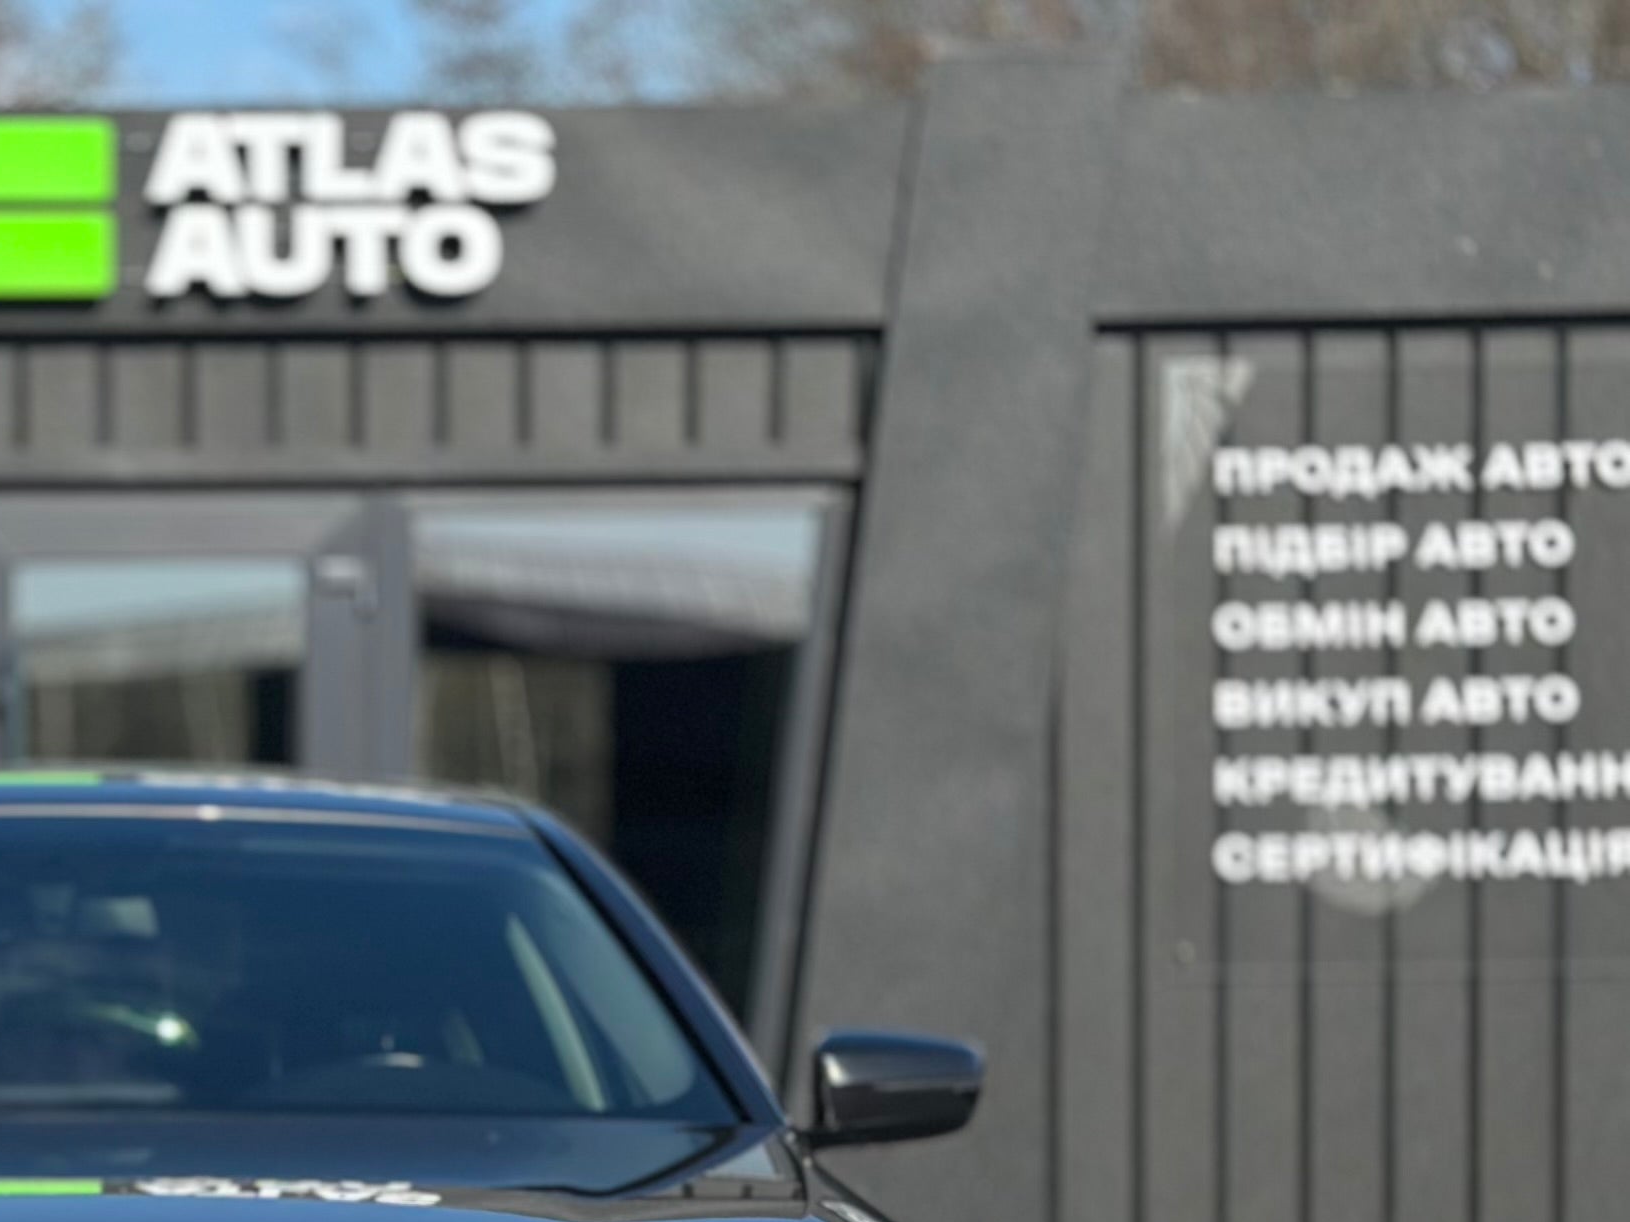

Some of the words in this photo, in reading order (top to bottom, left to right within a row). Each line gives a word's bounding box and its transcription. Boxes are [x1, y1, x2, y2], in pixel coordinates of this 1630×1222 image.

[145, 111, 557, 204] ATLAS
[146, 205, 504, 297] AUTO
[1213, 442, 1475, 500] ПРОДАЖ
[1480, 438, 1630, 490] АВТО
[1213, 523, 1409, 580] ПІДБІР
[1415, 518, 1576, 570] АВТО
[1211, 600, 1407, 651] ОБМІН
[1415, 595, 1576, 648] АВТО
[1213, 677, 1413, 729] ВИКУП
[1420, 673, 1581, 725] АВТО
